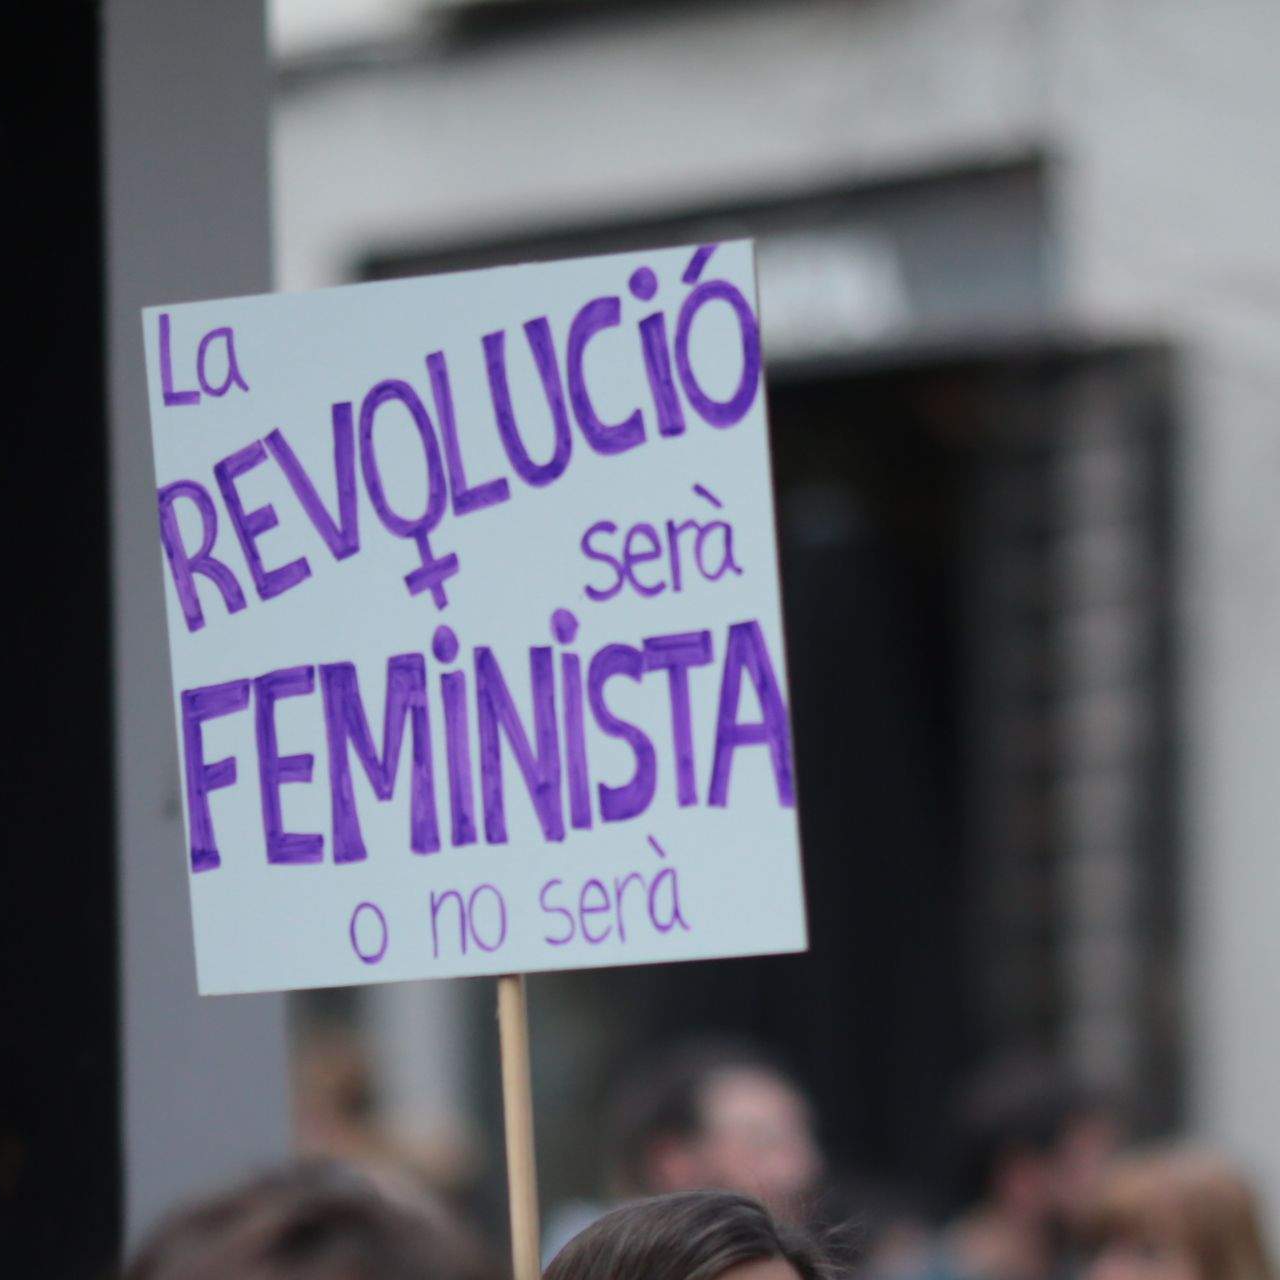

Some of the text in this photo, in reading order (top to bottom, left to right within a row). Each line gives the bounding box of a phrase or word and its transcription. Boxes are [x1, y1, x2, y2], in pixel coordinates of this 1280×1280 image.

[158, 313, 250, 407] La
[580, 483, 744, 602] serà
[349, 834, 691, 966] o no serà
